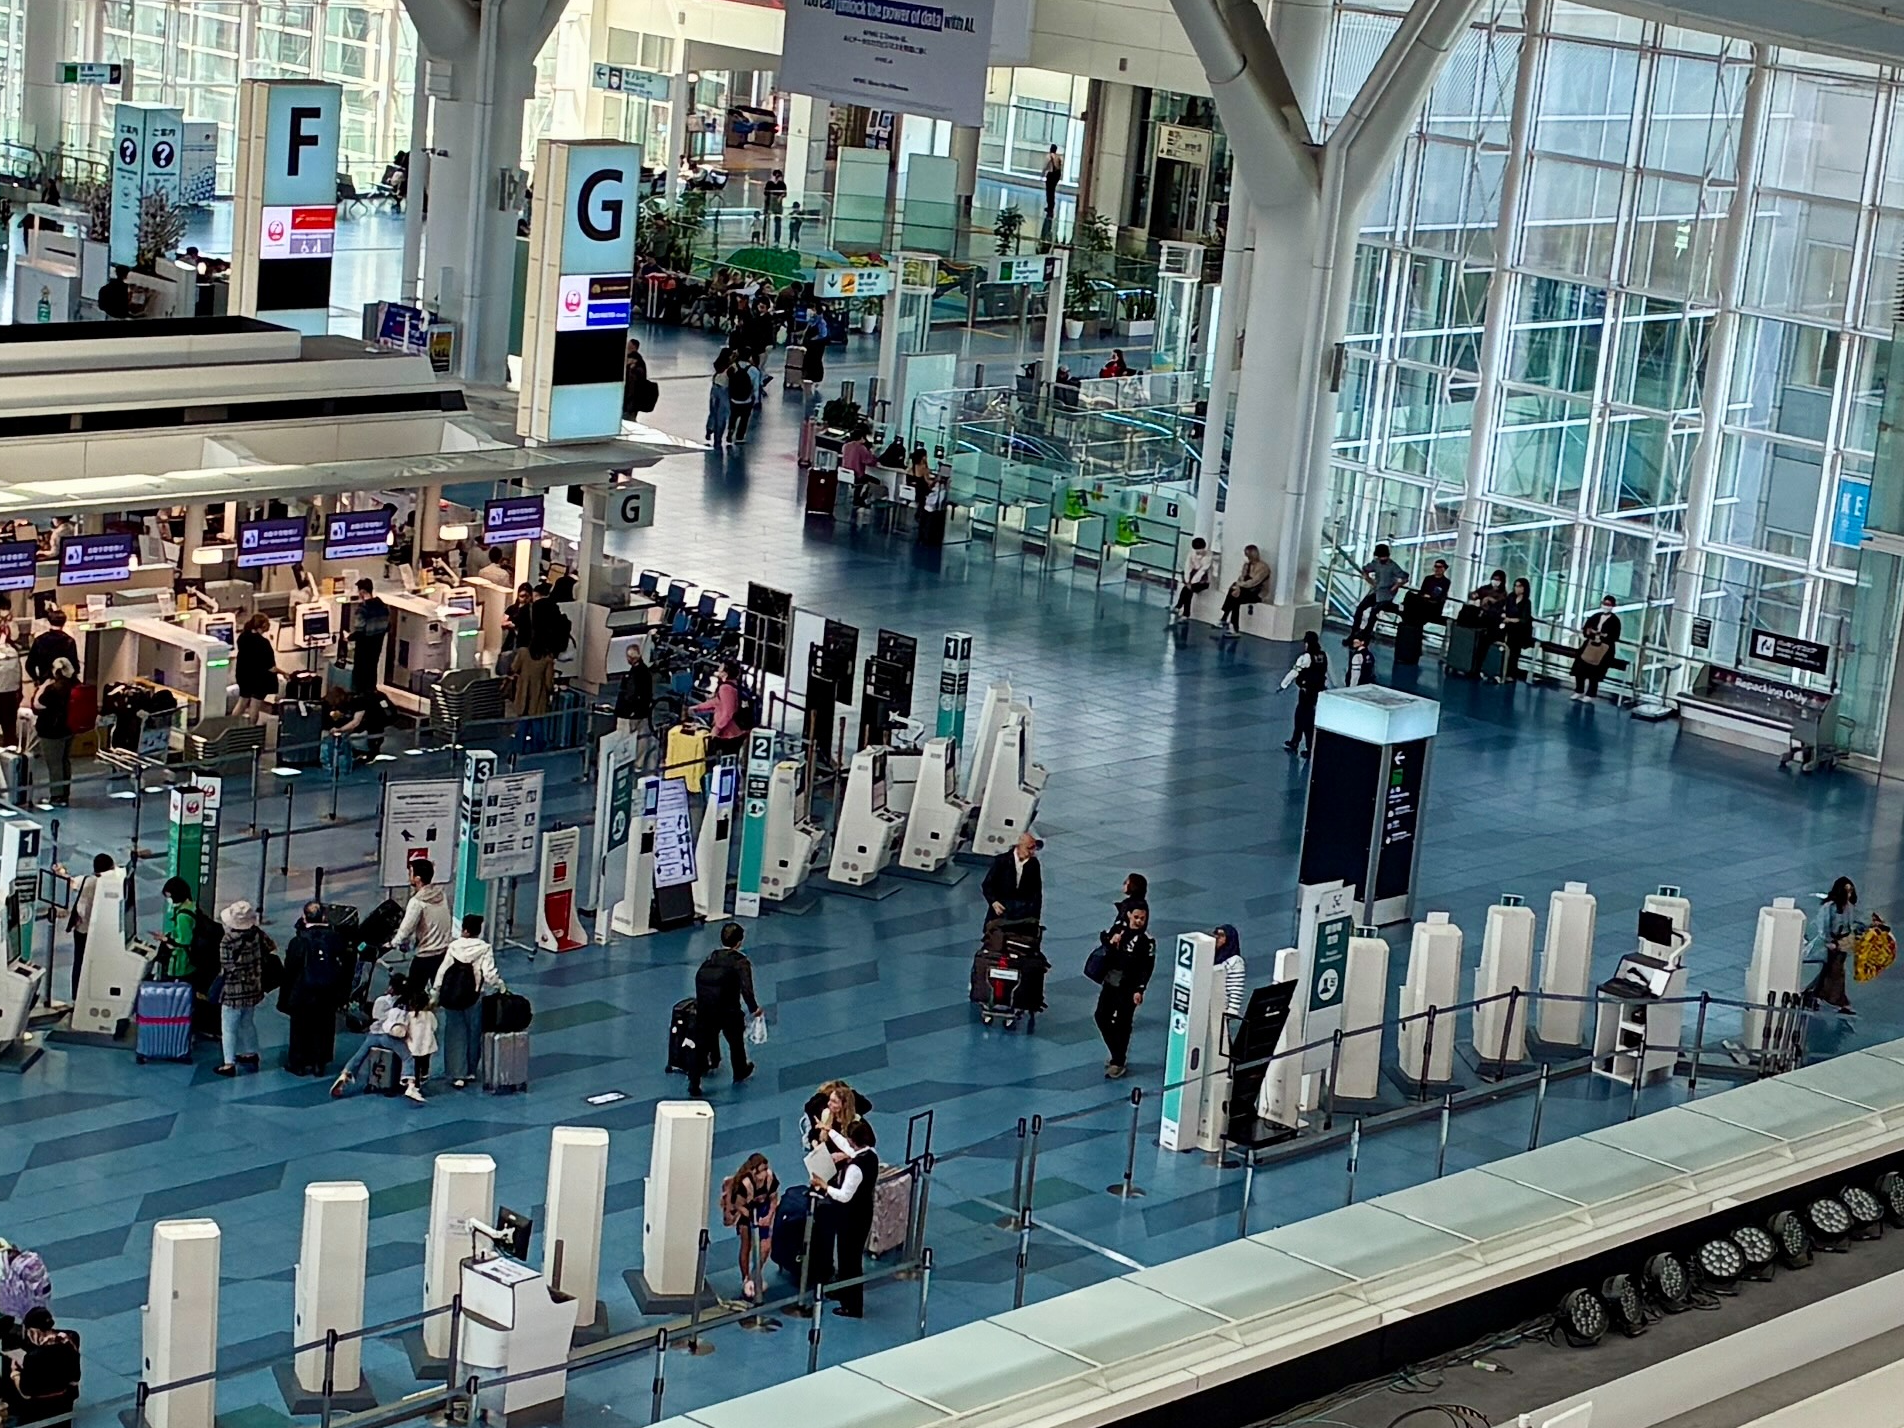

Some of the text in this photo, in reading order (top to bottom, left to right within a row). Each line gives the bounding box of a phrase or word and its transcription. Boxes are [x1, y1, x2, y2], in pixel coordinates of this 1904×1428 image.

[152, 128, 176, 137] ご案内
[287, 107, 321, 176] F
[577, 169, 623, 241] G
[621, 494, 640, 523] G
[948, 641, 955, 656] 1
[1735, 677, 1808, 705] Repacking Only
[755, 739, 768, 757] 2
[478, 761, 490, 780] 3
[24, 832, 33, 854] 1
[1179, 944, 1192, 966] 2
